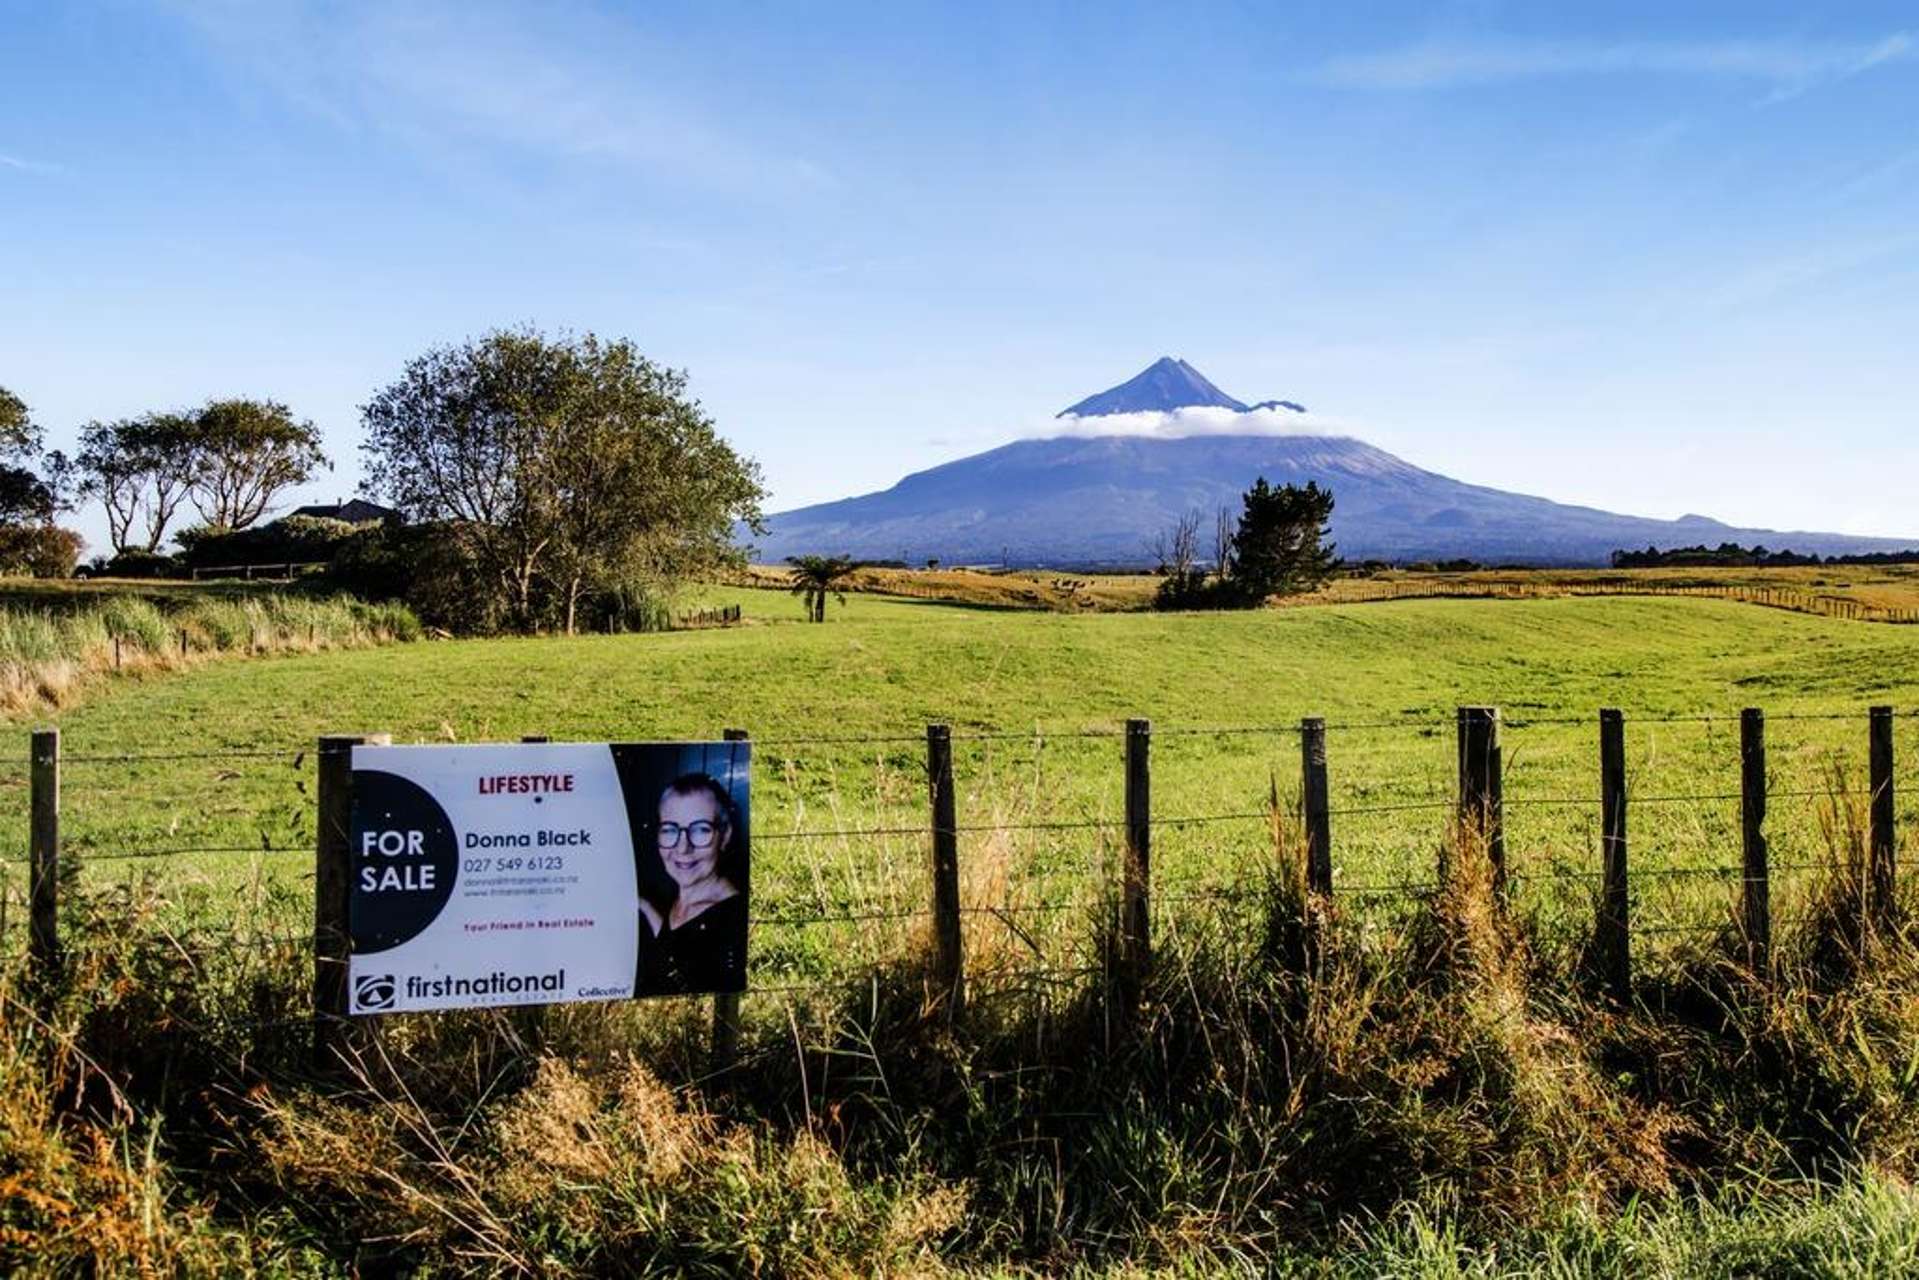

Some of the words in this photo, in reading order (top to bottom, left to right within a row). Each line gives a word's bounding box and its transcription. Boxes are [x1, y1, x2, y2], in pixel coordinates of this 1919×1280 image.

[479, 775, 574, 795] LIFESTYLE
[363, 830, 425, 857] FOR
[465, 832, 531, 849] Donna
[537, 829, 592, 847] Black
[464, 858, 492, 873] 027
[496, 857, 523, 872] 549
[527, 855, 563, 871] 6123
[361, 865, 436, 893] SALE
[490, 920, 524, 931] Friend
[538, 919, 562, 929] Real
[563, 918, 595, 929] Estate
[406, 969, 565, 999] firstnational
